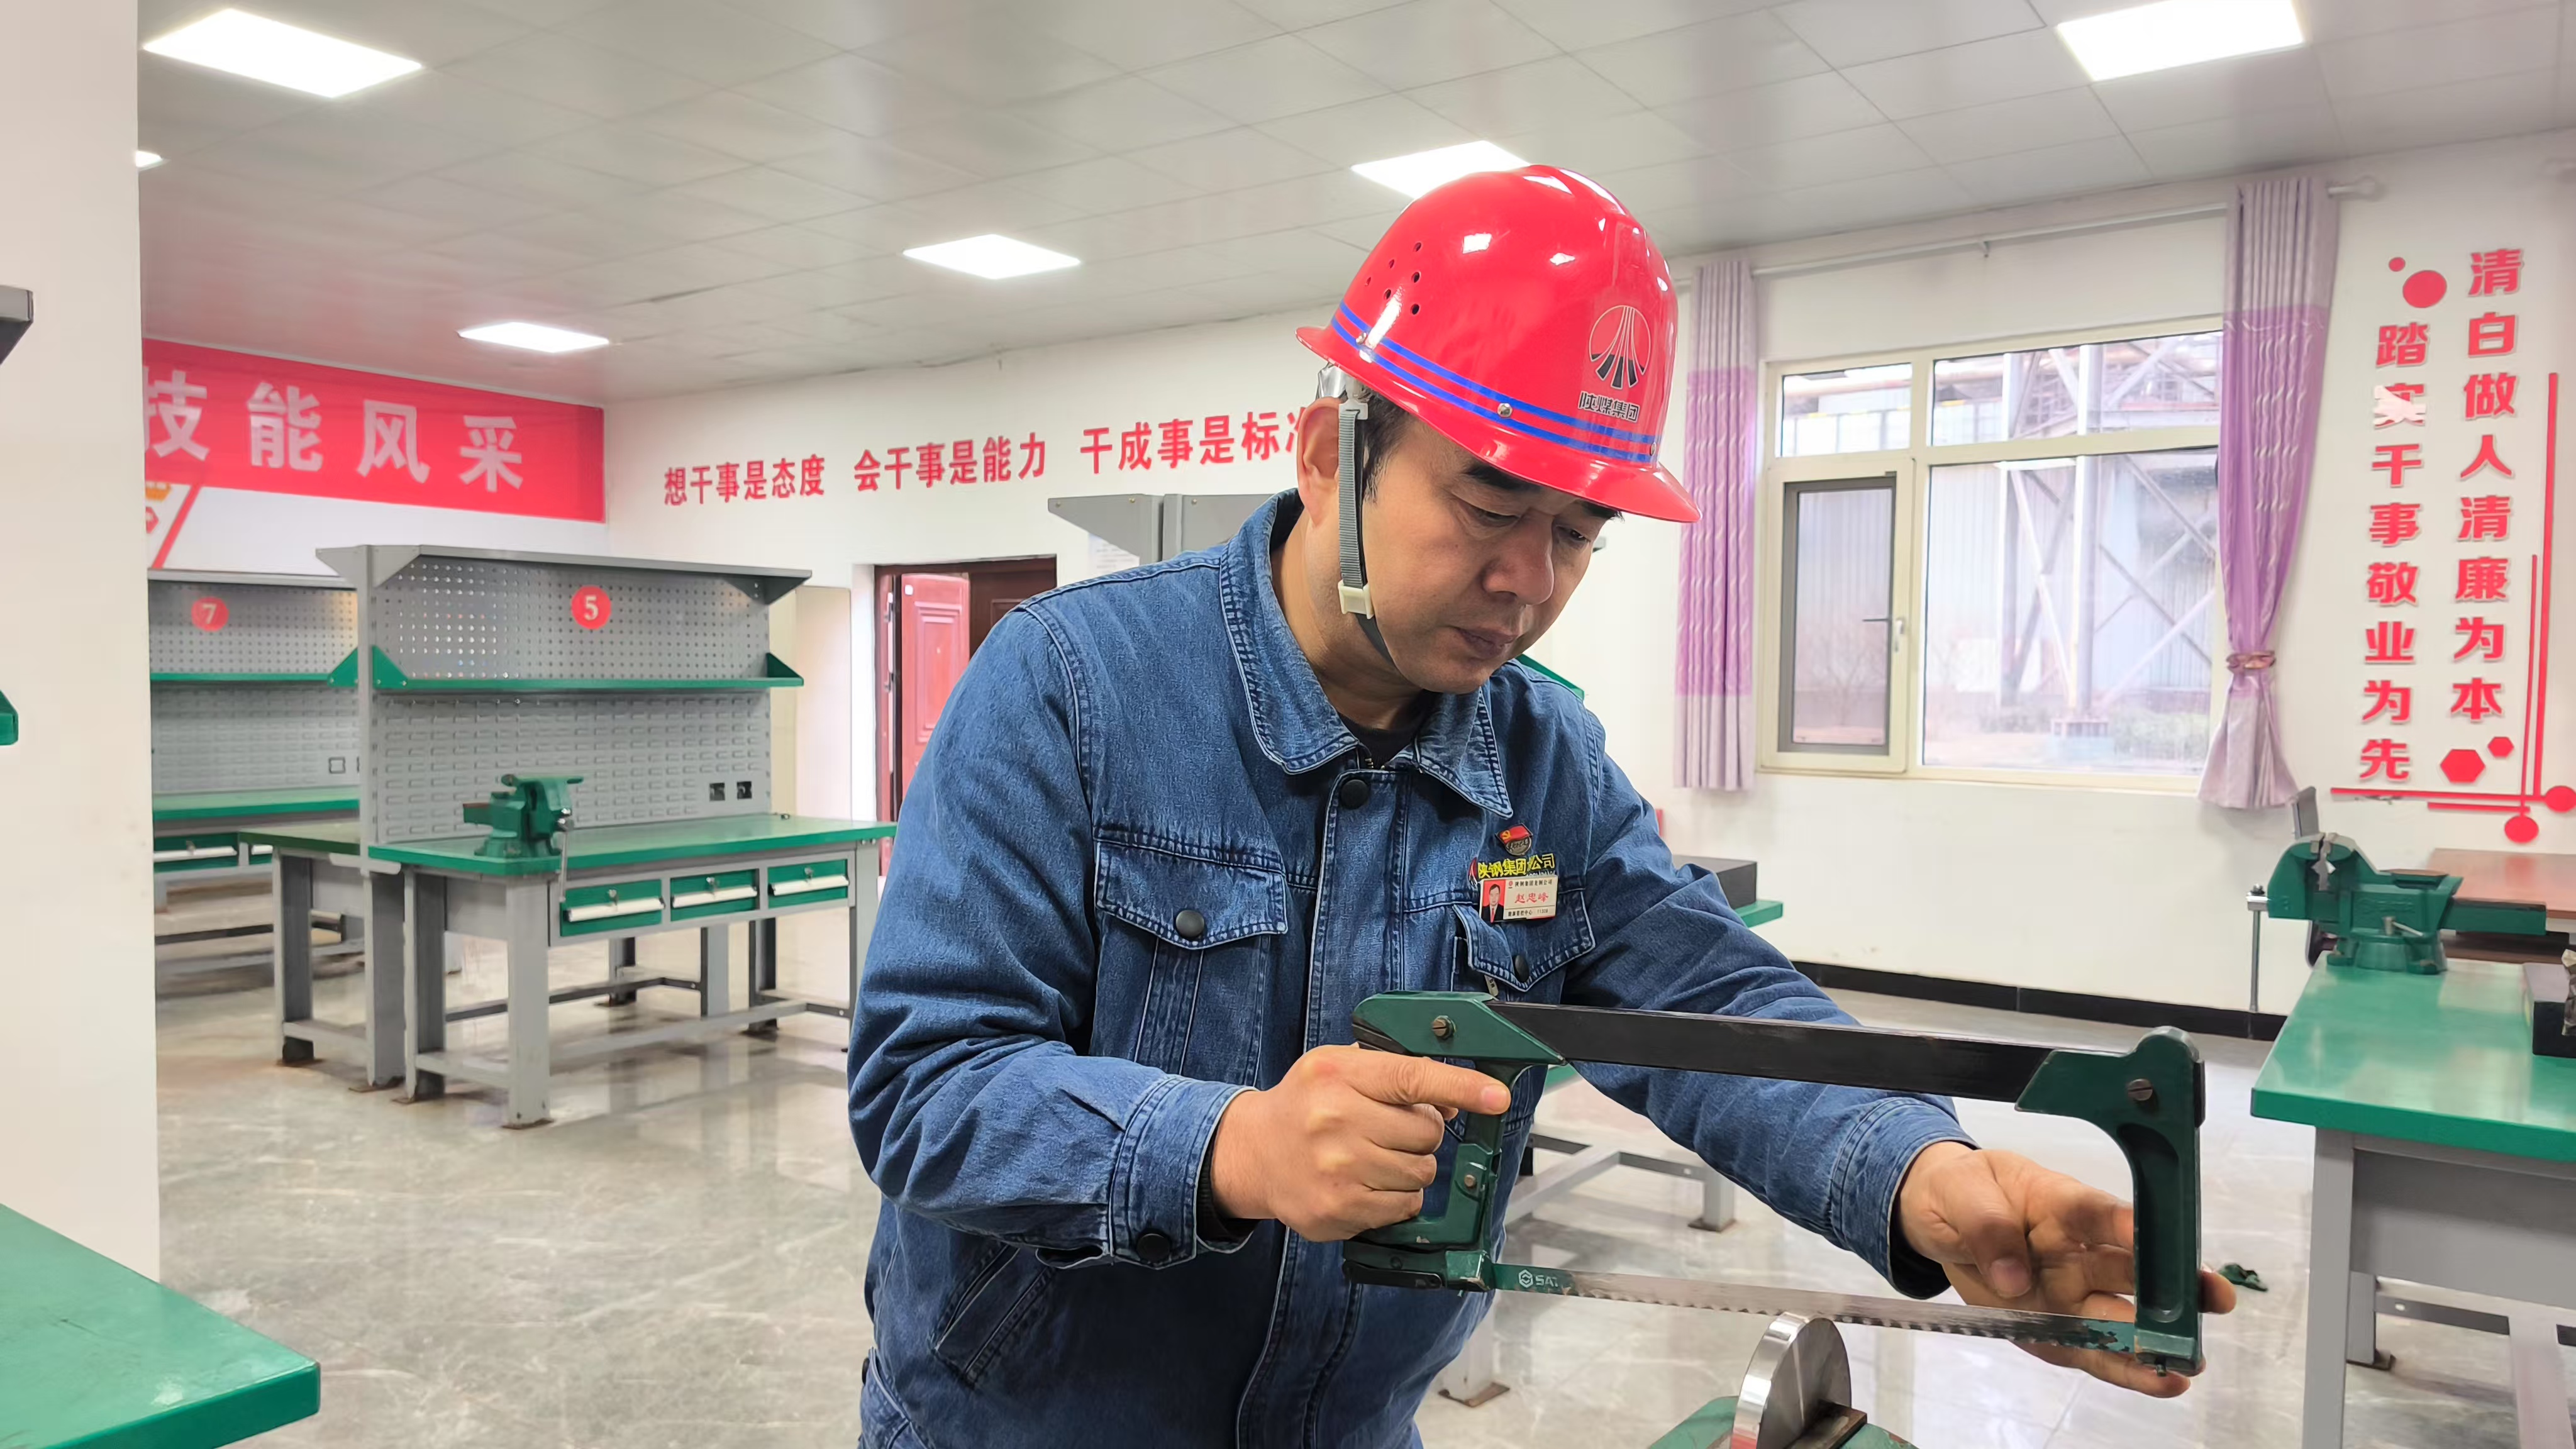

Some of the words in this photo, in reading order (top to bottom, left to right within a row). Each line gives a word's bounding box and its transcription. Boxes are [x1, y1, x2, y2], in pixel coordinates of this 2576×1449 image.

[1579, 391, 1640, 422] 陕煤集团
[143, 366, 523, 492] 技能风采
[664, 454, 825, 506] 想干事是态度
[854, 432, 1046, 492] 会干事是能力
[2451, 249, 2523, 722] 清白做人清廉为本
[202, 604, 216, 624] 7
[584, 595, 599, 621] 5
[1478, 853, 1555, 879] 陕钢集团公司
